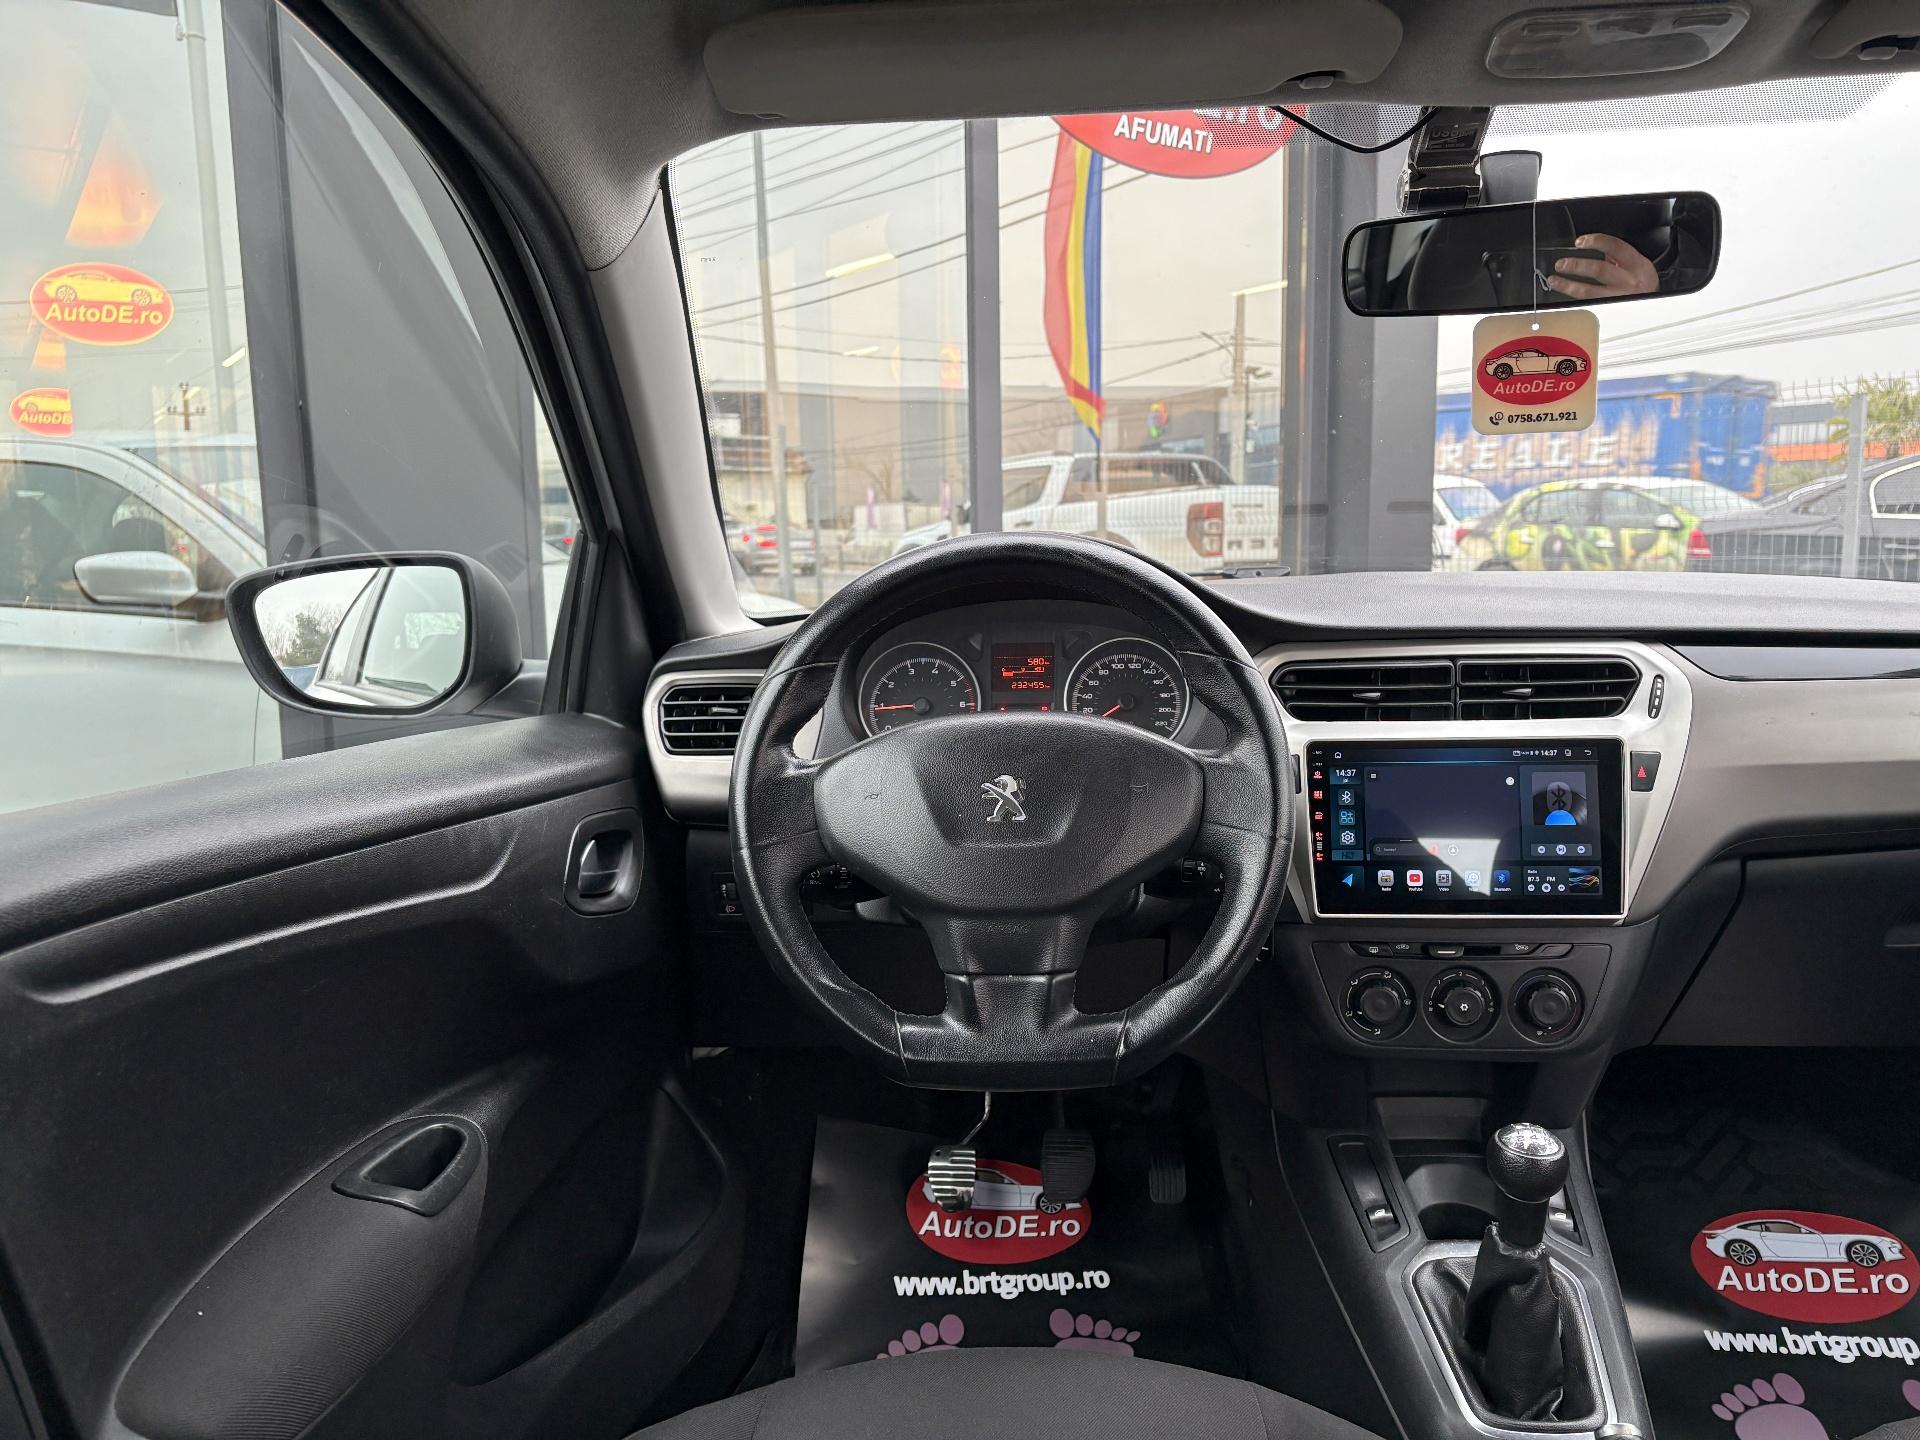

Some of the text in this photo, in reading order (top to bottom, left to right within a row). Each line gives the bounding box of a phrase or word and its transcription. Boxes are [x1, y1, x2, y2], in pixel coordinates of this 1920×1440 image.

[1113, 114, 1215, 154] AFUMATI
[44, 303, 164, 325] AutoDE.ro
[1493, 379, 1577, 395] AutoDE.ro
[1507, 411, 1578, 424] 0758.671.921
[1027, 657, 1045, 666] 580
[1011, 681, 1045, 689] 232455
[1335, 769, 1357, 777] 14:37
[918, 1210, 1081, 1240] AutoDE.ro
[893, 1268, 1111, 1300] www.brtgroup.ro
[1716, 1265, 1910, 1295] AutoDE.ro
